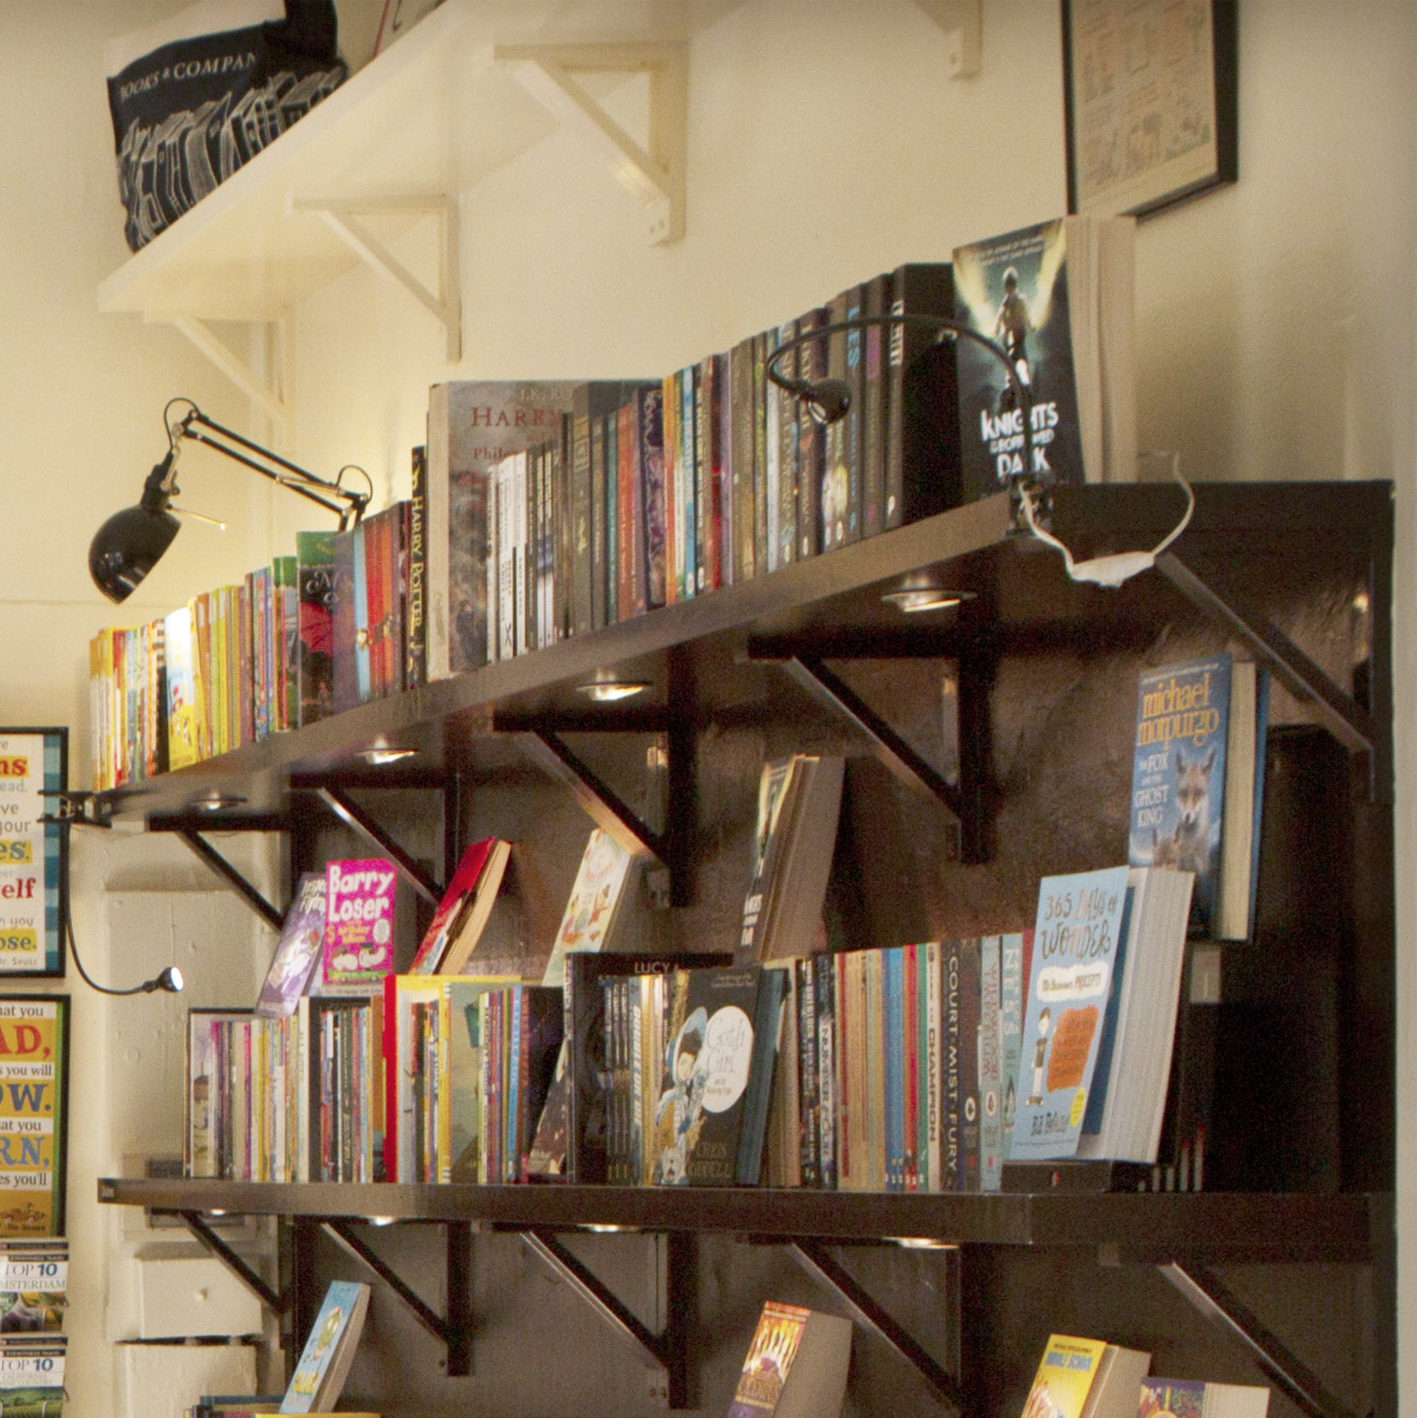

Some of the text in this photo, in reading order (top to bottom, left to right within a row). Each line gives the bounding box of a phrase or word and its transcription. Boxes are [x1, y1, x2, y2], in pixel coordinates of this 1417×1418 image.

[997, 448, 1050, 480] DAK
[1142, 671, 1211, 719] michael
[1136, 706, 1220, 751] morpurgo
[1134, 783, 1171, 808] GHOST
[1136, 808, 1164, 829] KING
[328, 865, 395, 899] Barry
[327, 895, 390, 923] Loser
